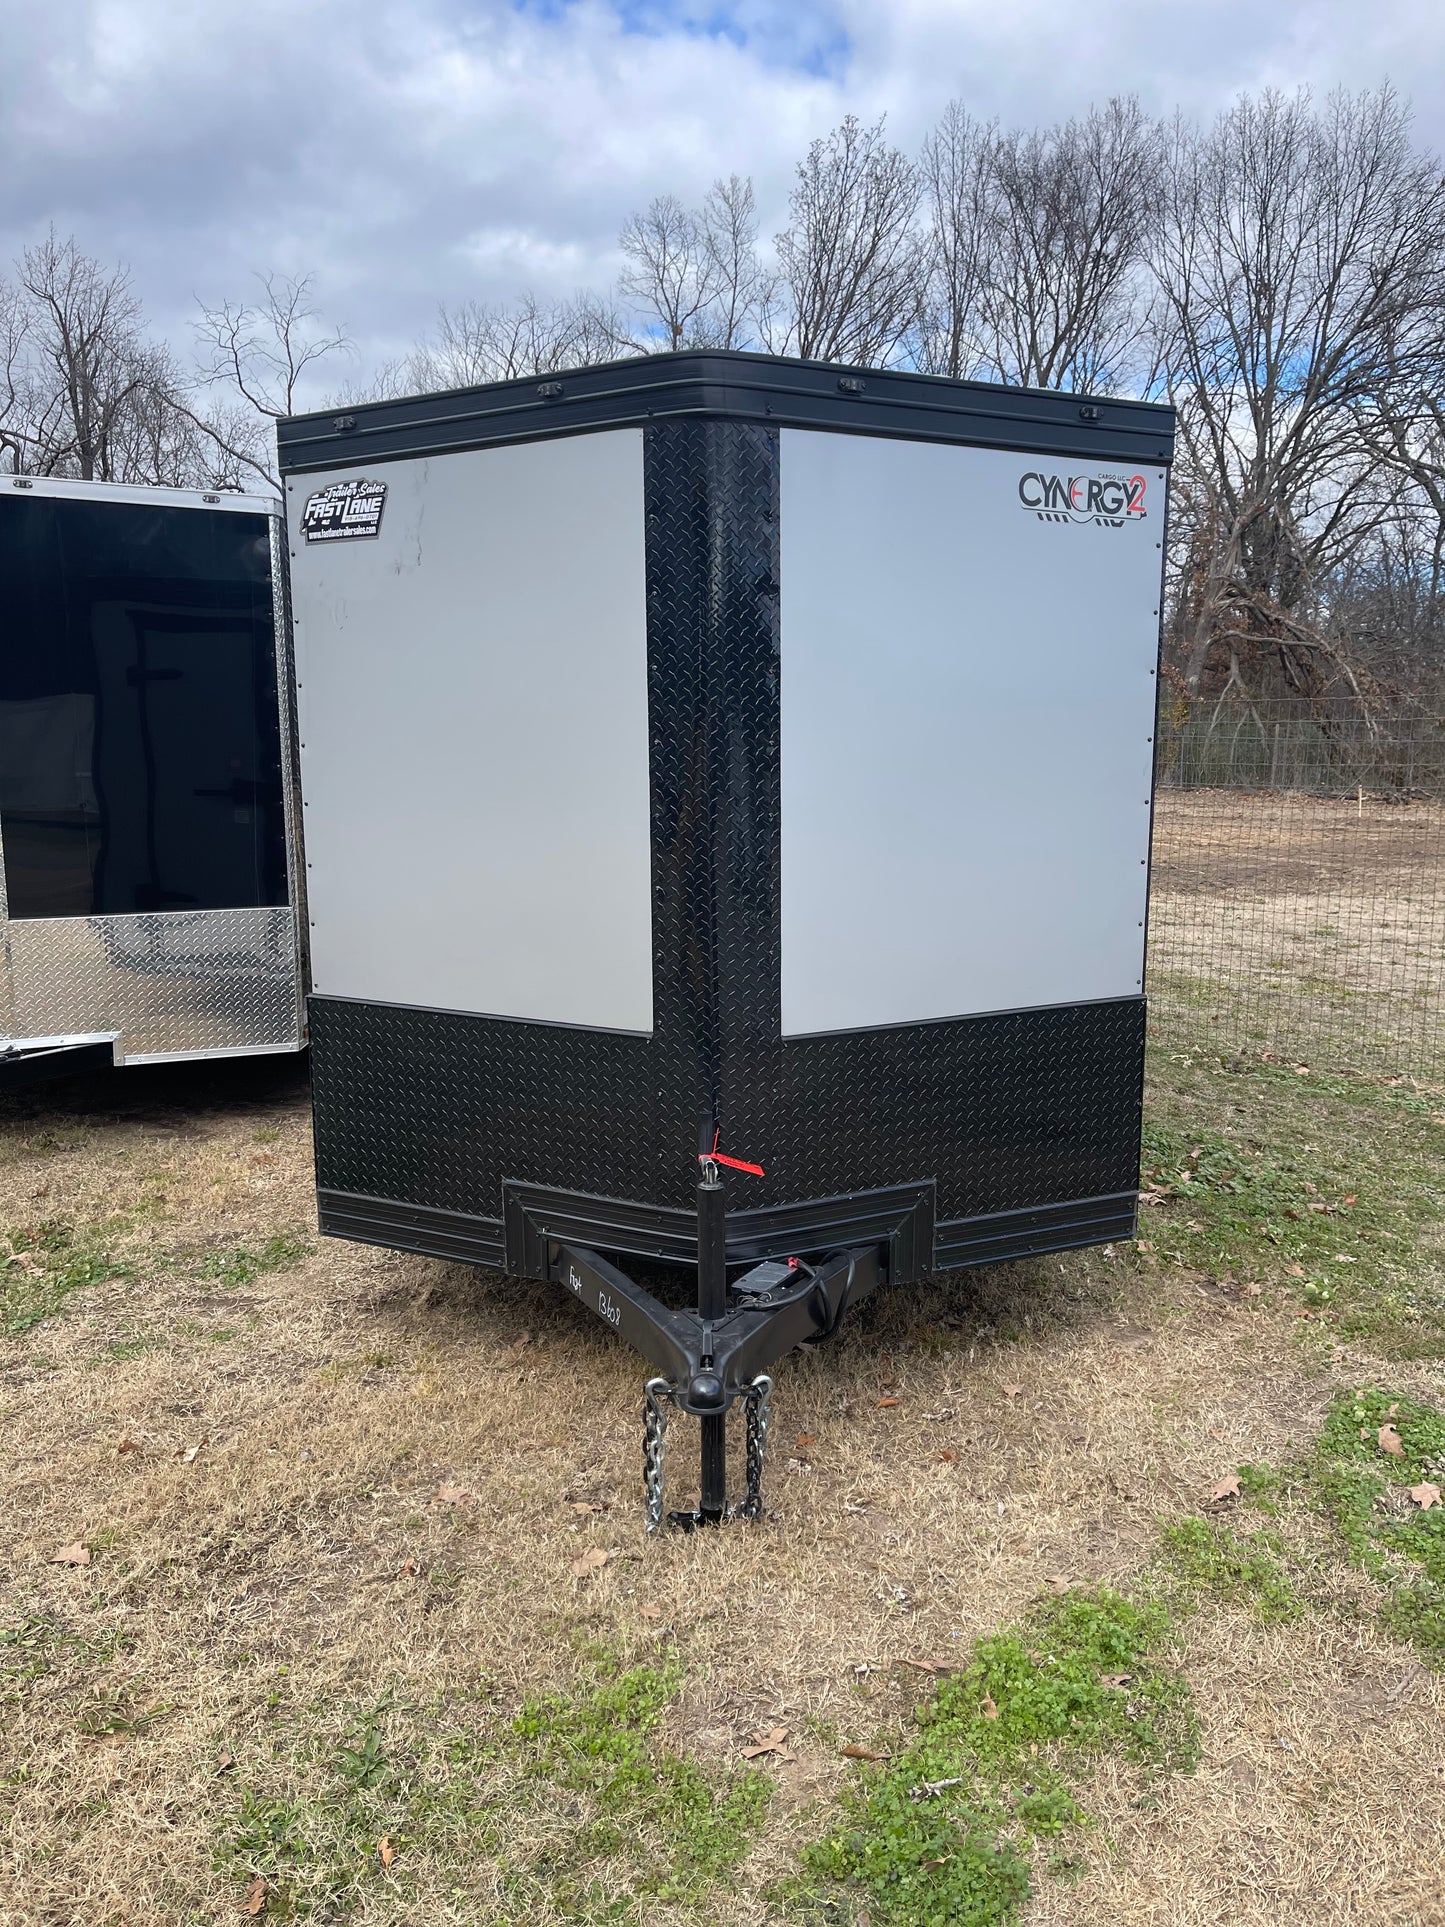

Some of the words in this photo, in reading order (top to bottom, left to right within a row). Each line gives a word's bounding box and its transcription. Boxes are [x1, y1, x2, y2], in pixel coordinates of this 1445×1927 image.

[327, 485, 357, 499] Trailer
[358, 482, 386, 496] Sales
[308, 525, 377, 539] www.fastlanetrailersales.com
